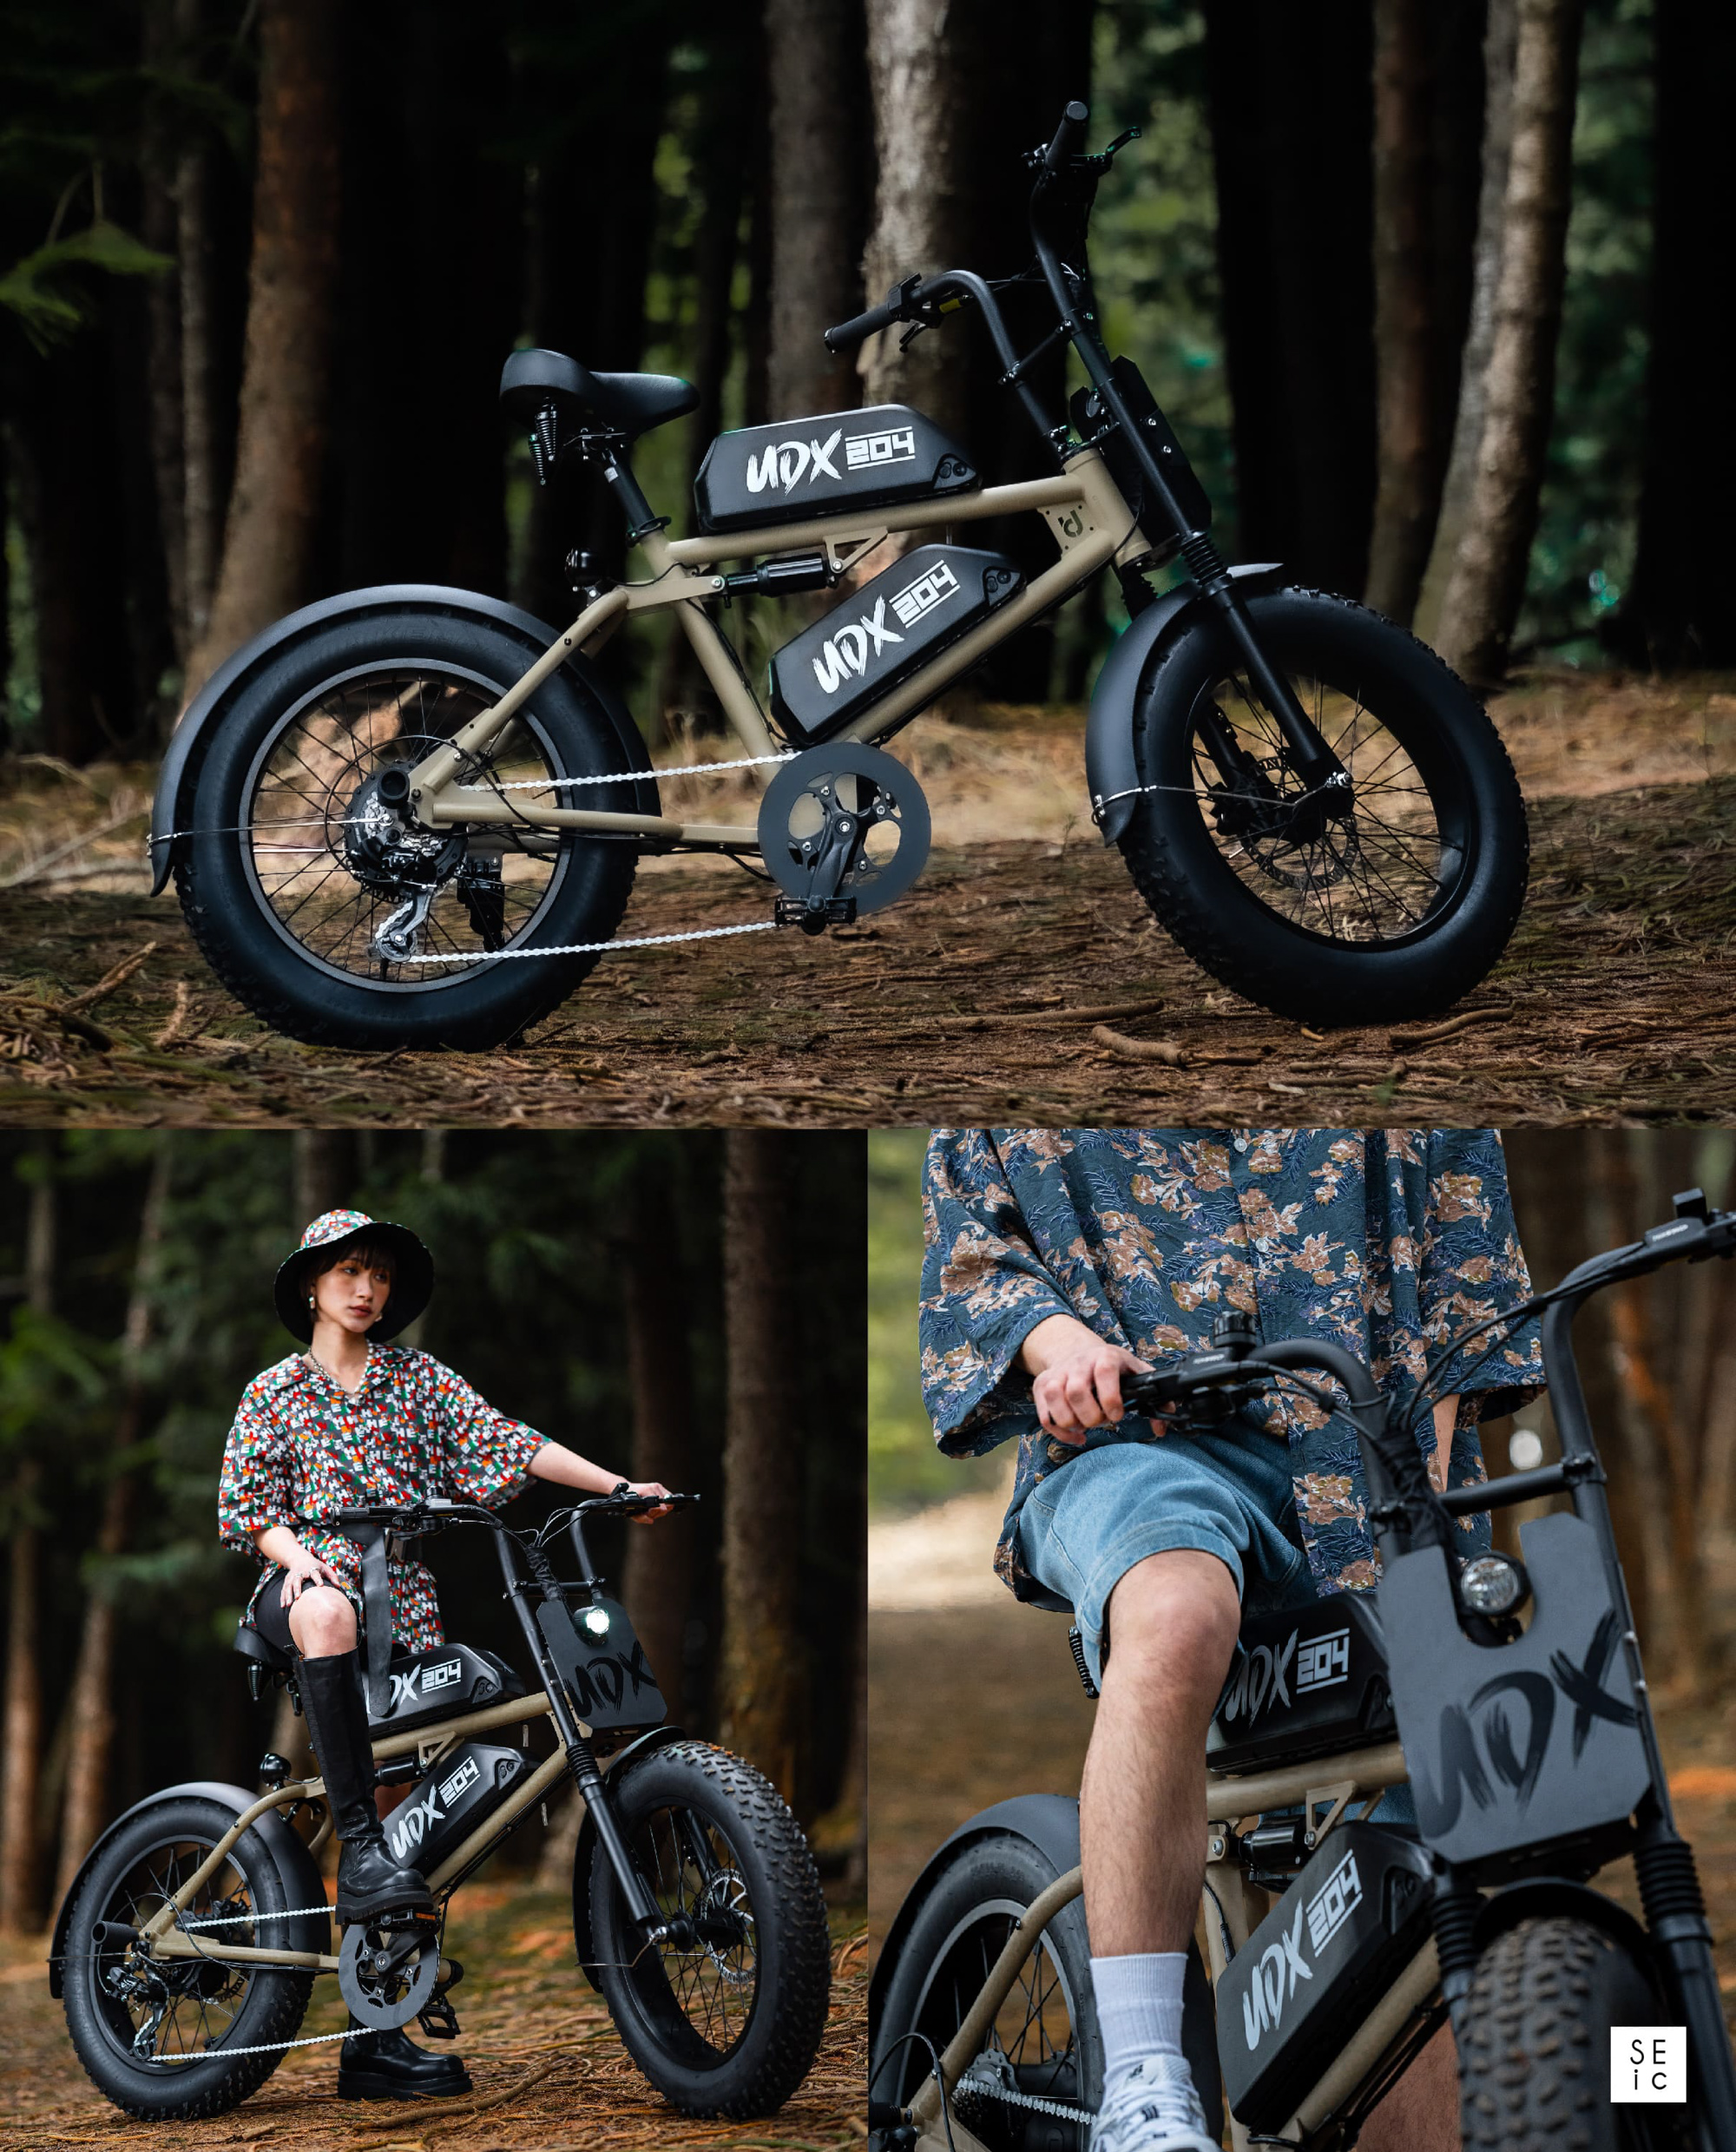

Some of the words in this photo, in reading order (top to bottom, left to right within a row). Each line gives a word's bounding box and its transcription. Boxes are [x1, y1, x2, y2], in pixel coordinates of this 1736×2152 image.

[746, 428, 842, 496] UDX
[845, 430, 915, 466] 204
[812, 594, 904, 694] UDX
[891, 563, 958, 625] 204
[422, 1662, 462, 1690] 204
[564, 1641, 657, 1717] UDX
[1297, 1635, 1350, 1687] 204
[1410, 1609, 1641, 1840] UDX
[392, 1782, 445, 1859] UDX
[440, 1758, 479, 1804] 204
[1243, 1897, 1313, 2051] UDX
[1307, 1856, 1362, 1951] 204
